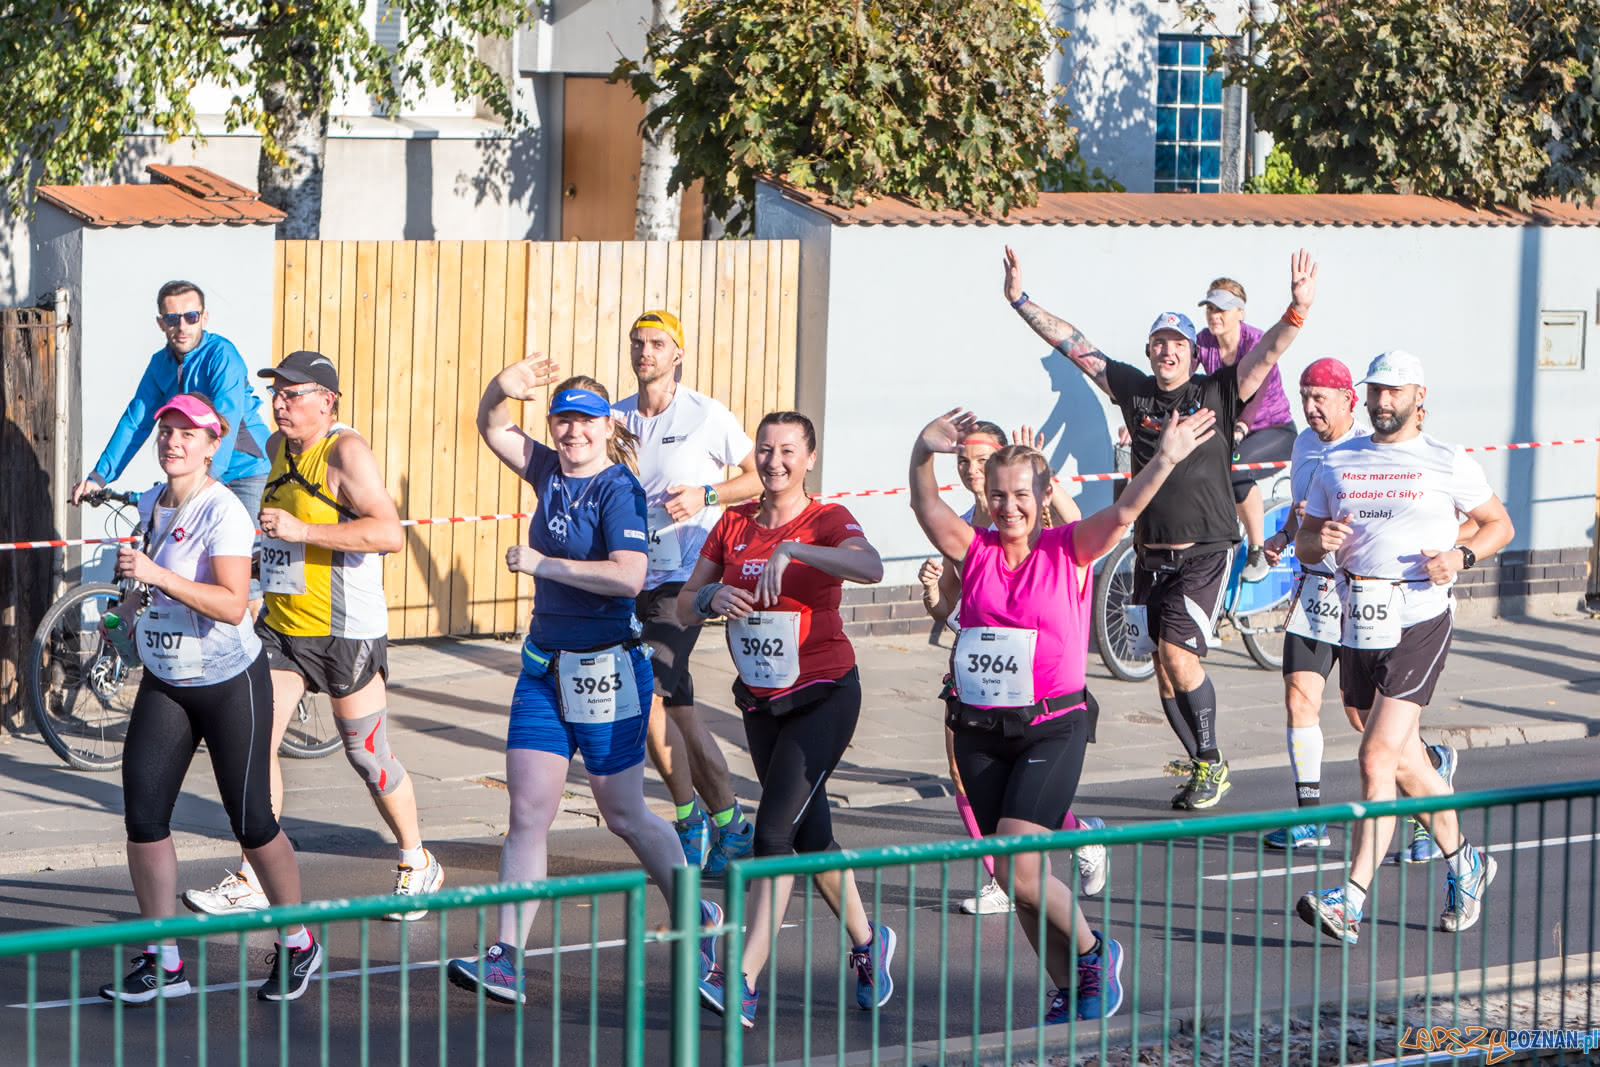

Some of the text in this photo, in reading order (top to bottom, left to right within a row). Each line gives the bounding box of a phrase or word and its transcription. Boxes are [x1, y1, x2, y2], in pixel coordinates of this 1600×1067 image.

[1342, 471, 1422, 480] Masz marzenie?
[1336, 490, 1424, 500] Co dodaje Ci siły?
[1359, 509, 1394, 520] Działaj.
[648, 530, 661, 545] 4
[262, 546, 291, 567] 3921
[1305, 598, 1339, 619] 2624
[144, 630, 183, 650] 3707
[740, 637, 784, 657] 3962
[967, 653, 1018, 675] 3964
[571, 672, 623, 695] 3963
